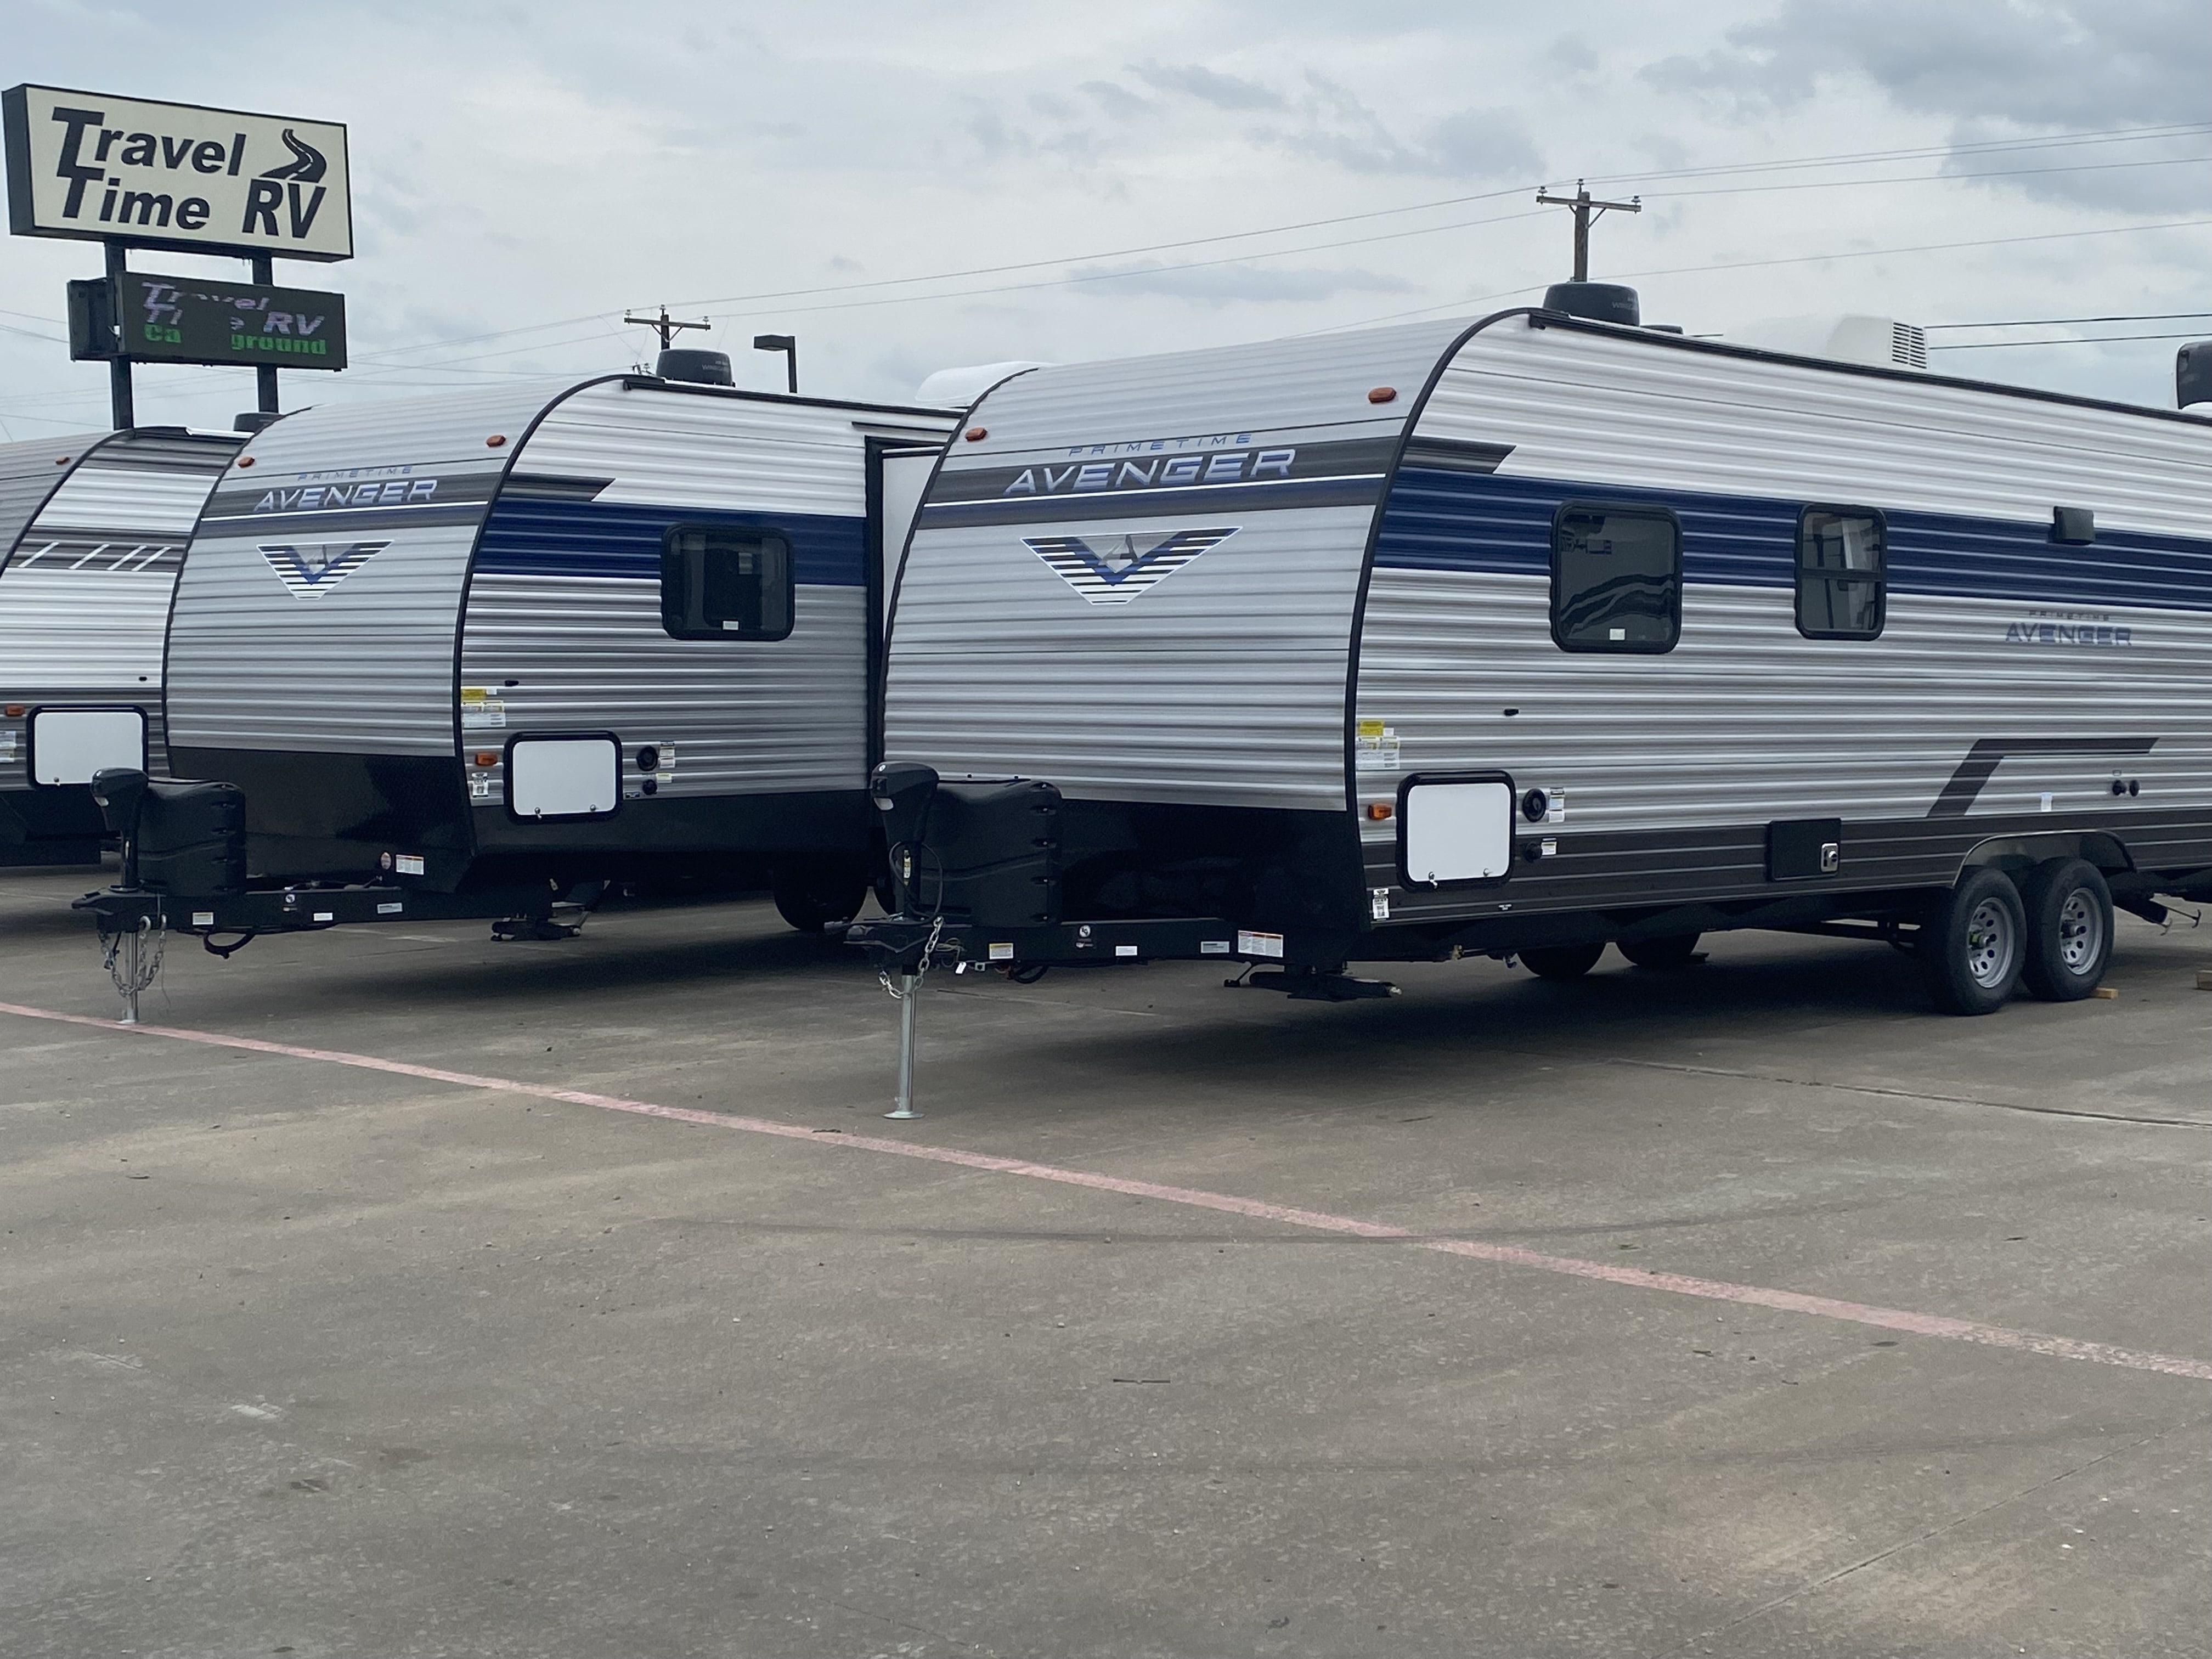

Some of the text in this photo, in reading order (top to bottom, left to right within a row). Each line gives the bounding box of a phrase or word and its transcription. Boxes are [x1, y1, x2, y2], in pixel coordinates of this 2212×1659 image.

[52, 106, 247, 177] Travel
[57, 166, 326, 239] Time RV
[263, 311, 325, 336] RV
[1068, 435, 1252, 456] PRIMETIME
[1003, 449, 1296, 495] AVENGER
[253, 479, 438, 512] AVENGER
[2005, 622, 2132, 646] AVENGER
